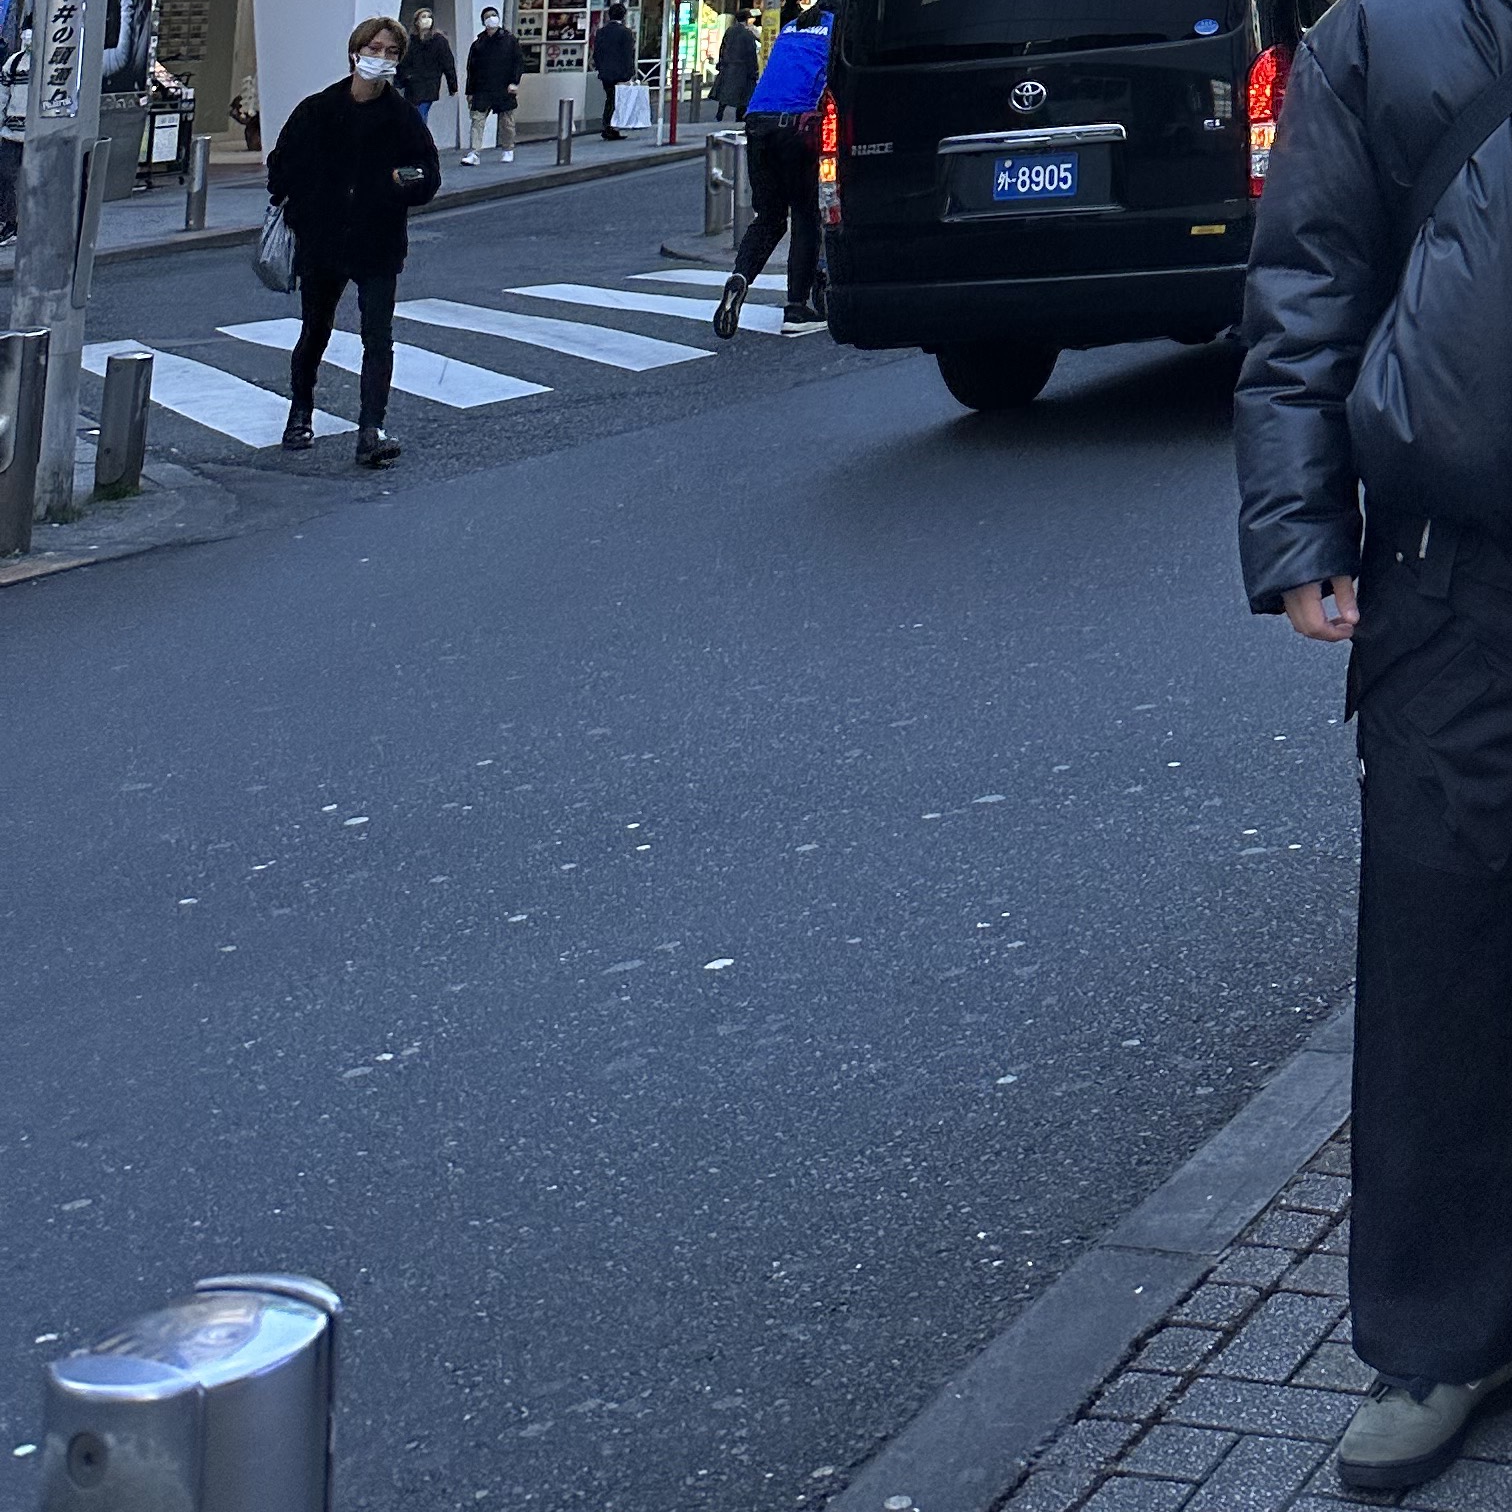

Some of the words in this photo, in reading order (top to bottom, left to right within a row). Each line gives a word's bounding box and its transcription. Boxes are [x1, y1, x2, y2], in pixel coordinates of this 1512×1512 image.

[46, 3, 78, 104] 井の頭通り
